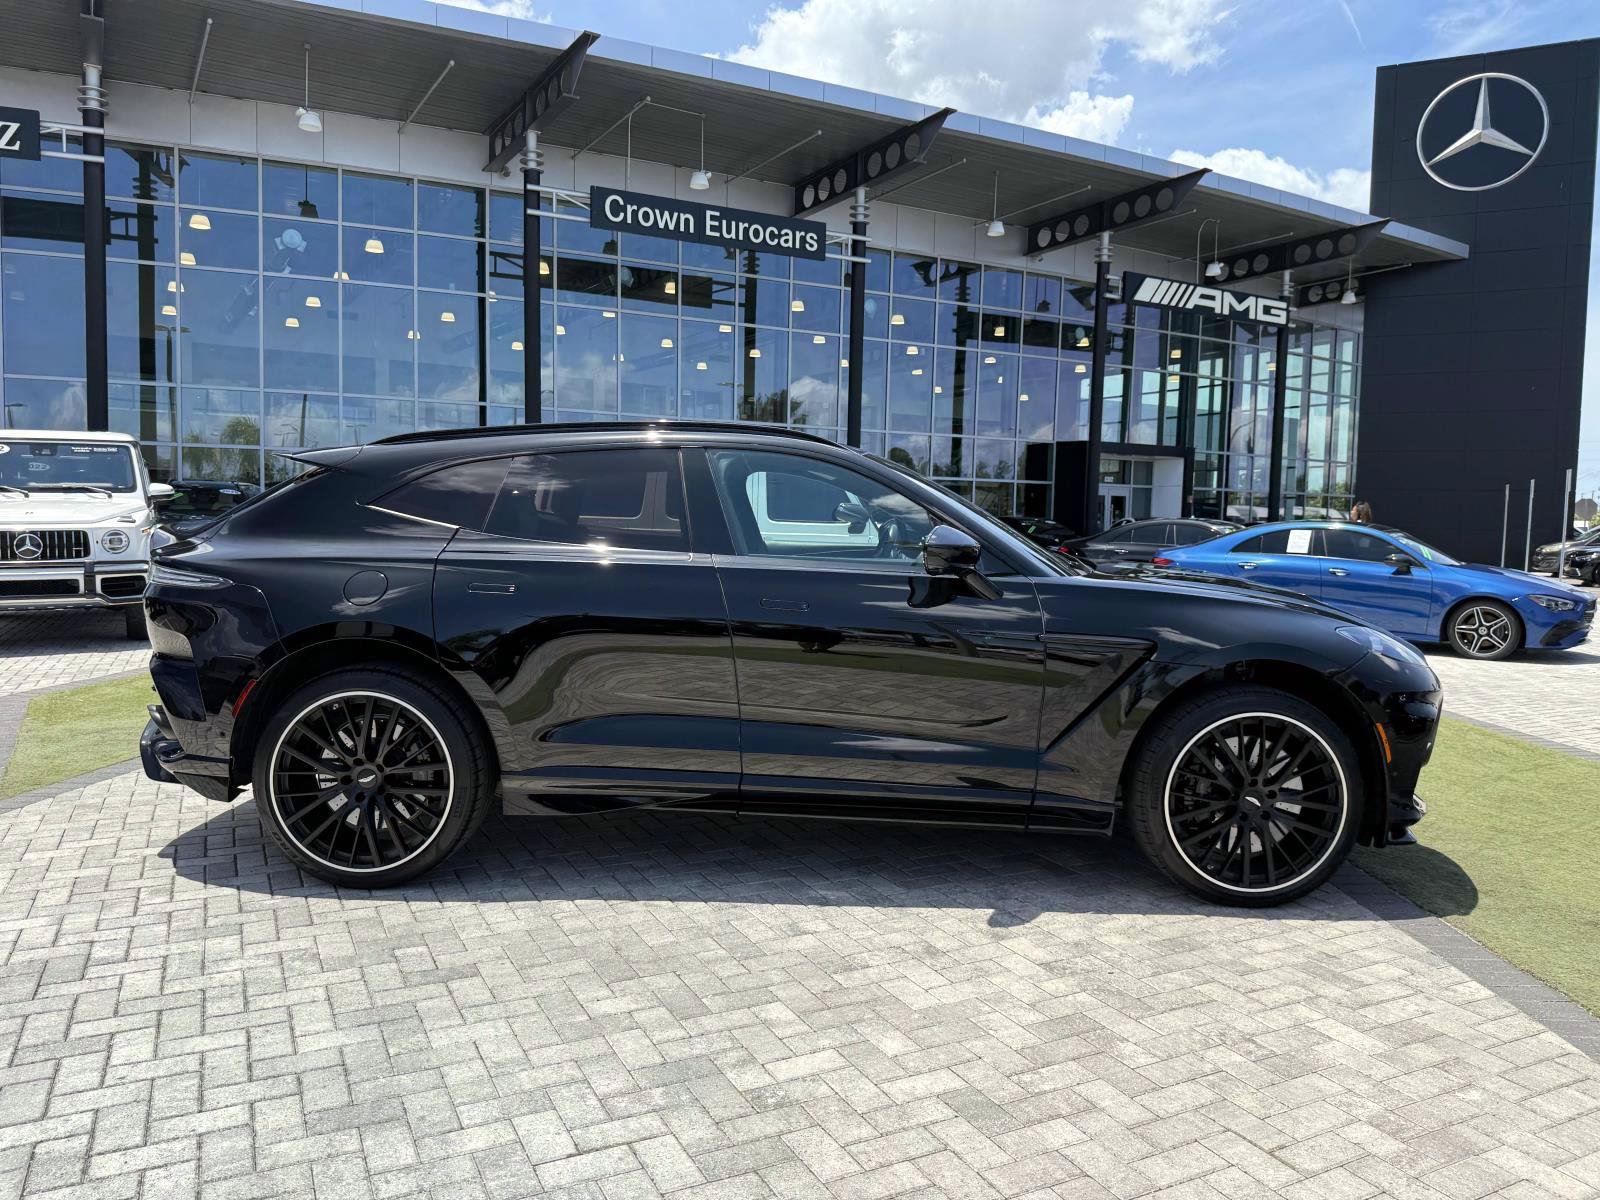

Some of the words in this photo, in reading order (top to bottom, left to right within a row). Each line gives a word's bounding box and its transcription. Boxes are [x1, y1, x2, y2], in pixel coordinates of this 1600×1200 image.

[604, 194, 695, 234] Crown
[705, 210, 819, 252] Eurocars
[1185, 286, 1288, 325] AMG
